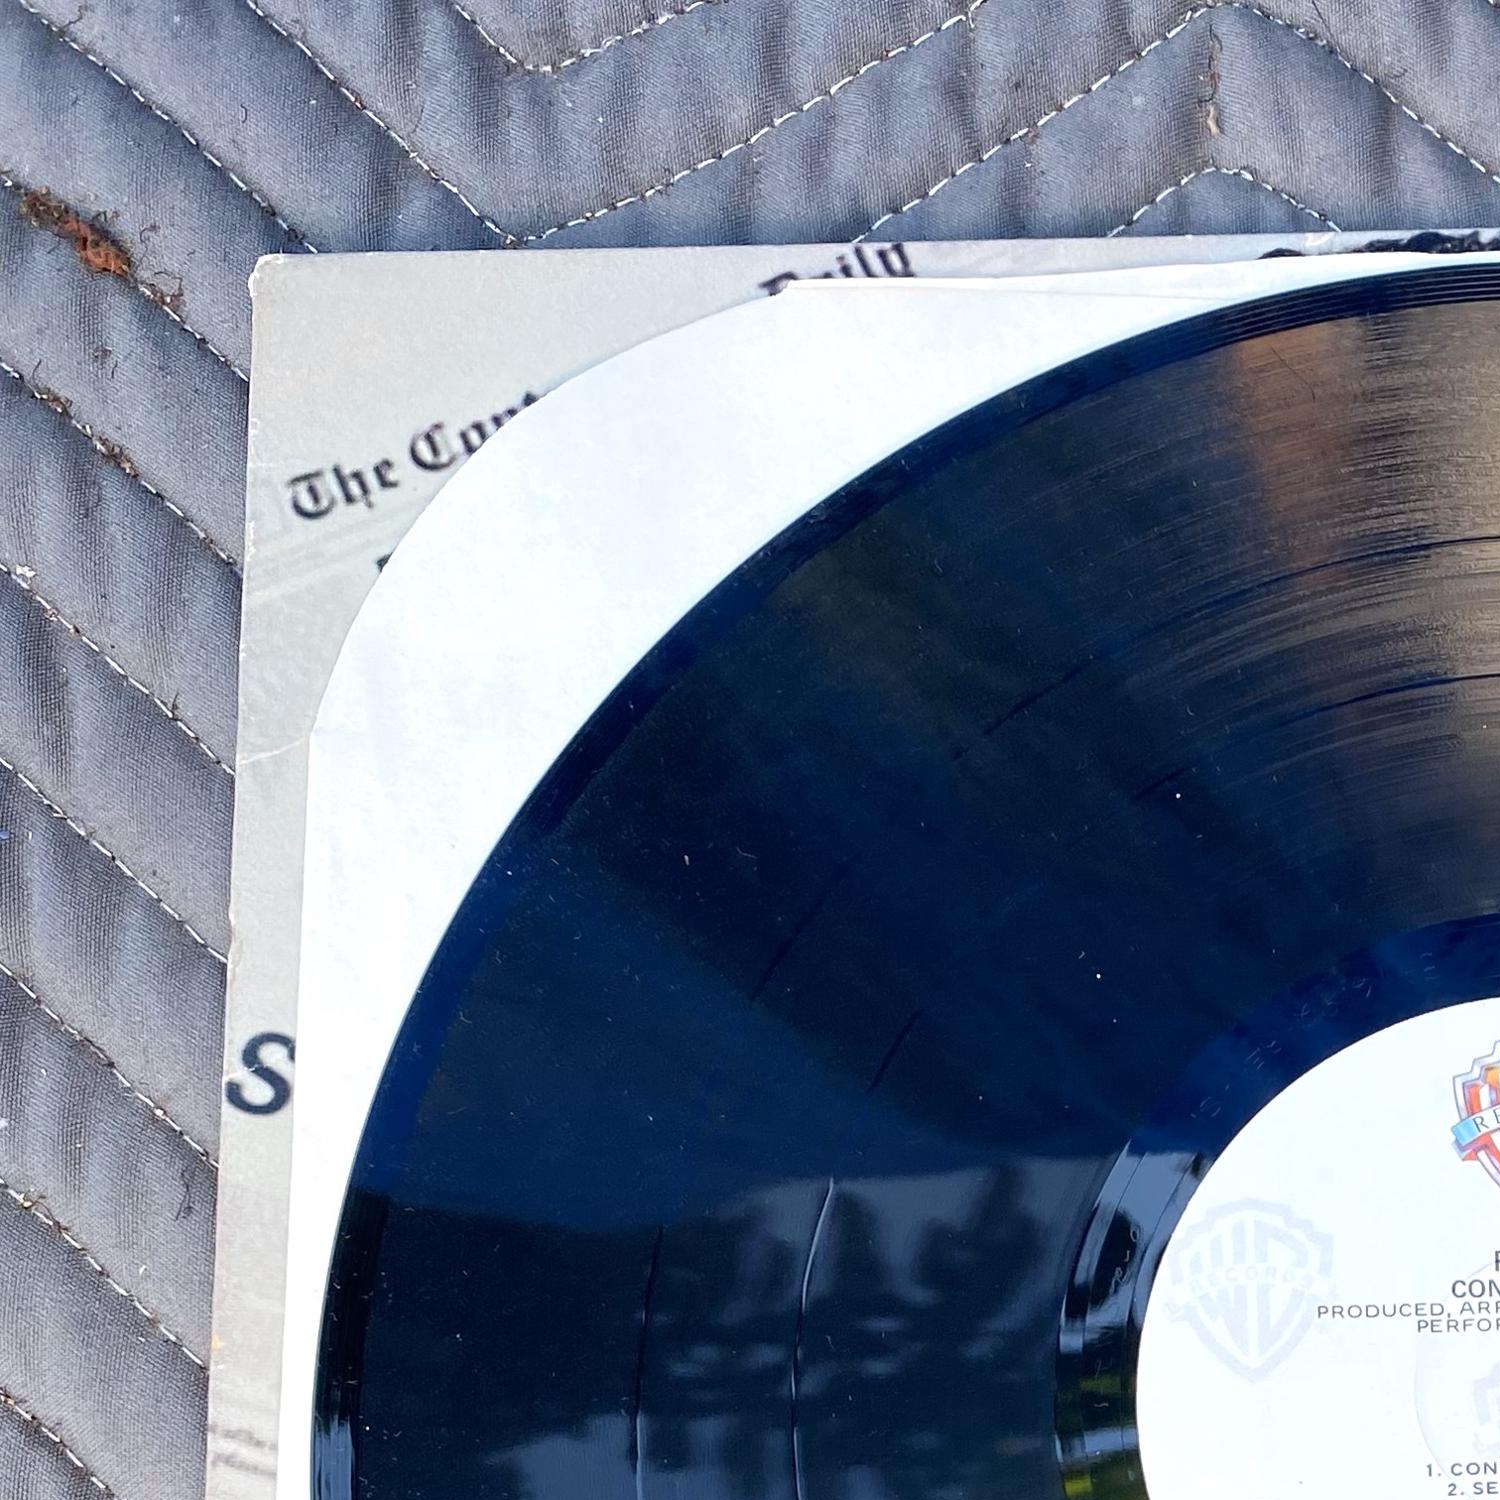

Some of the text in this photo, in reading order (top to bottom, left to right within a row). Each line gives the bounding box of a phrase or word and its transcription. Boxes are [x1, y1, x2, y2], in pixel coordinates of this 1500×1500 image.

[287, 459, 399, 520] The
[1317, 1302, 1451, 1319] PRODUCED,
[1426, 1463, 1443, 1477] 1.
[1447, 1482, 1465, 1497] 2.
